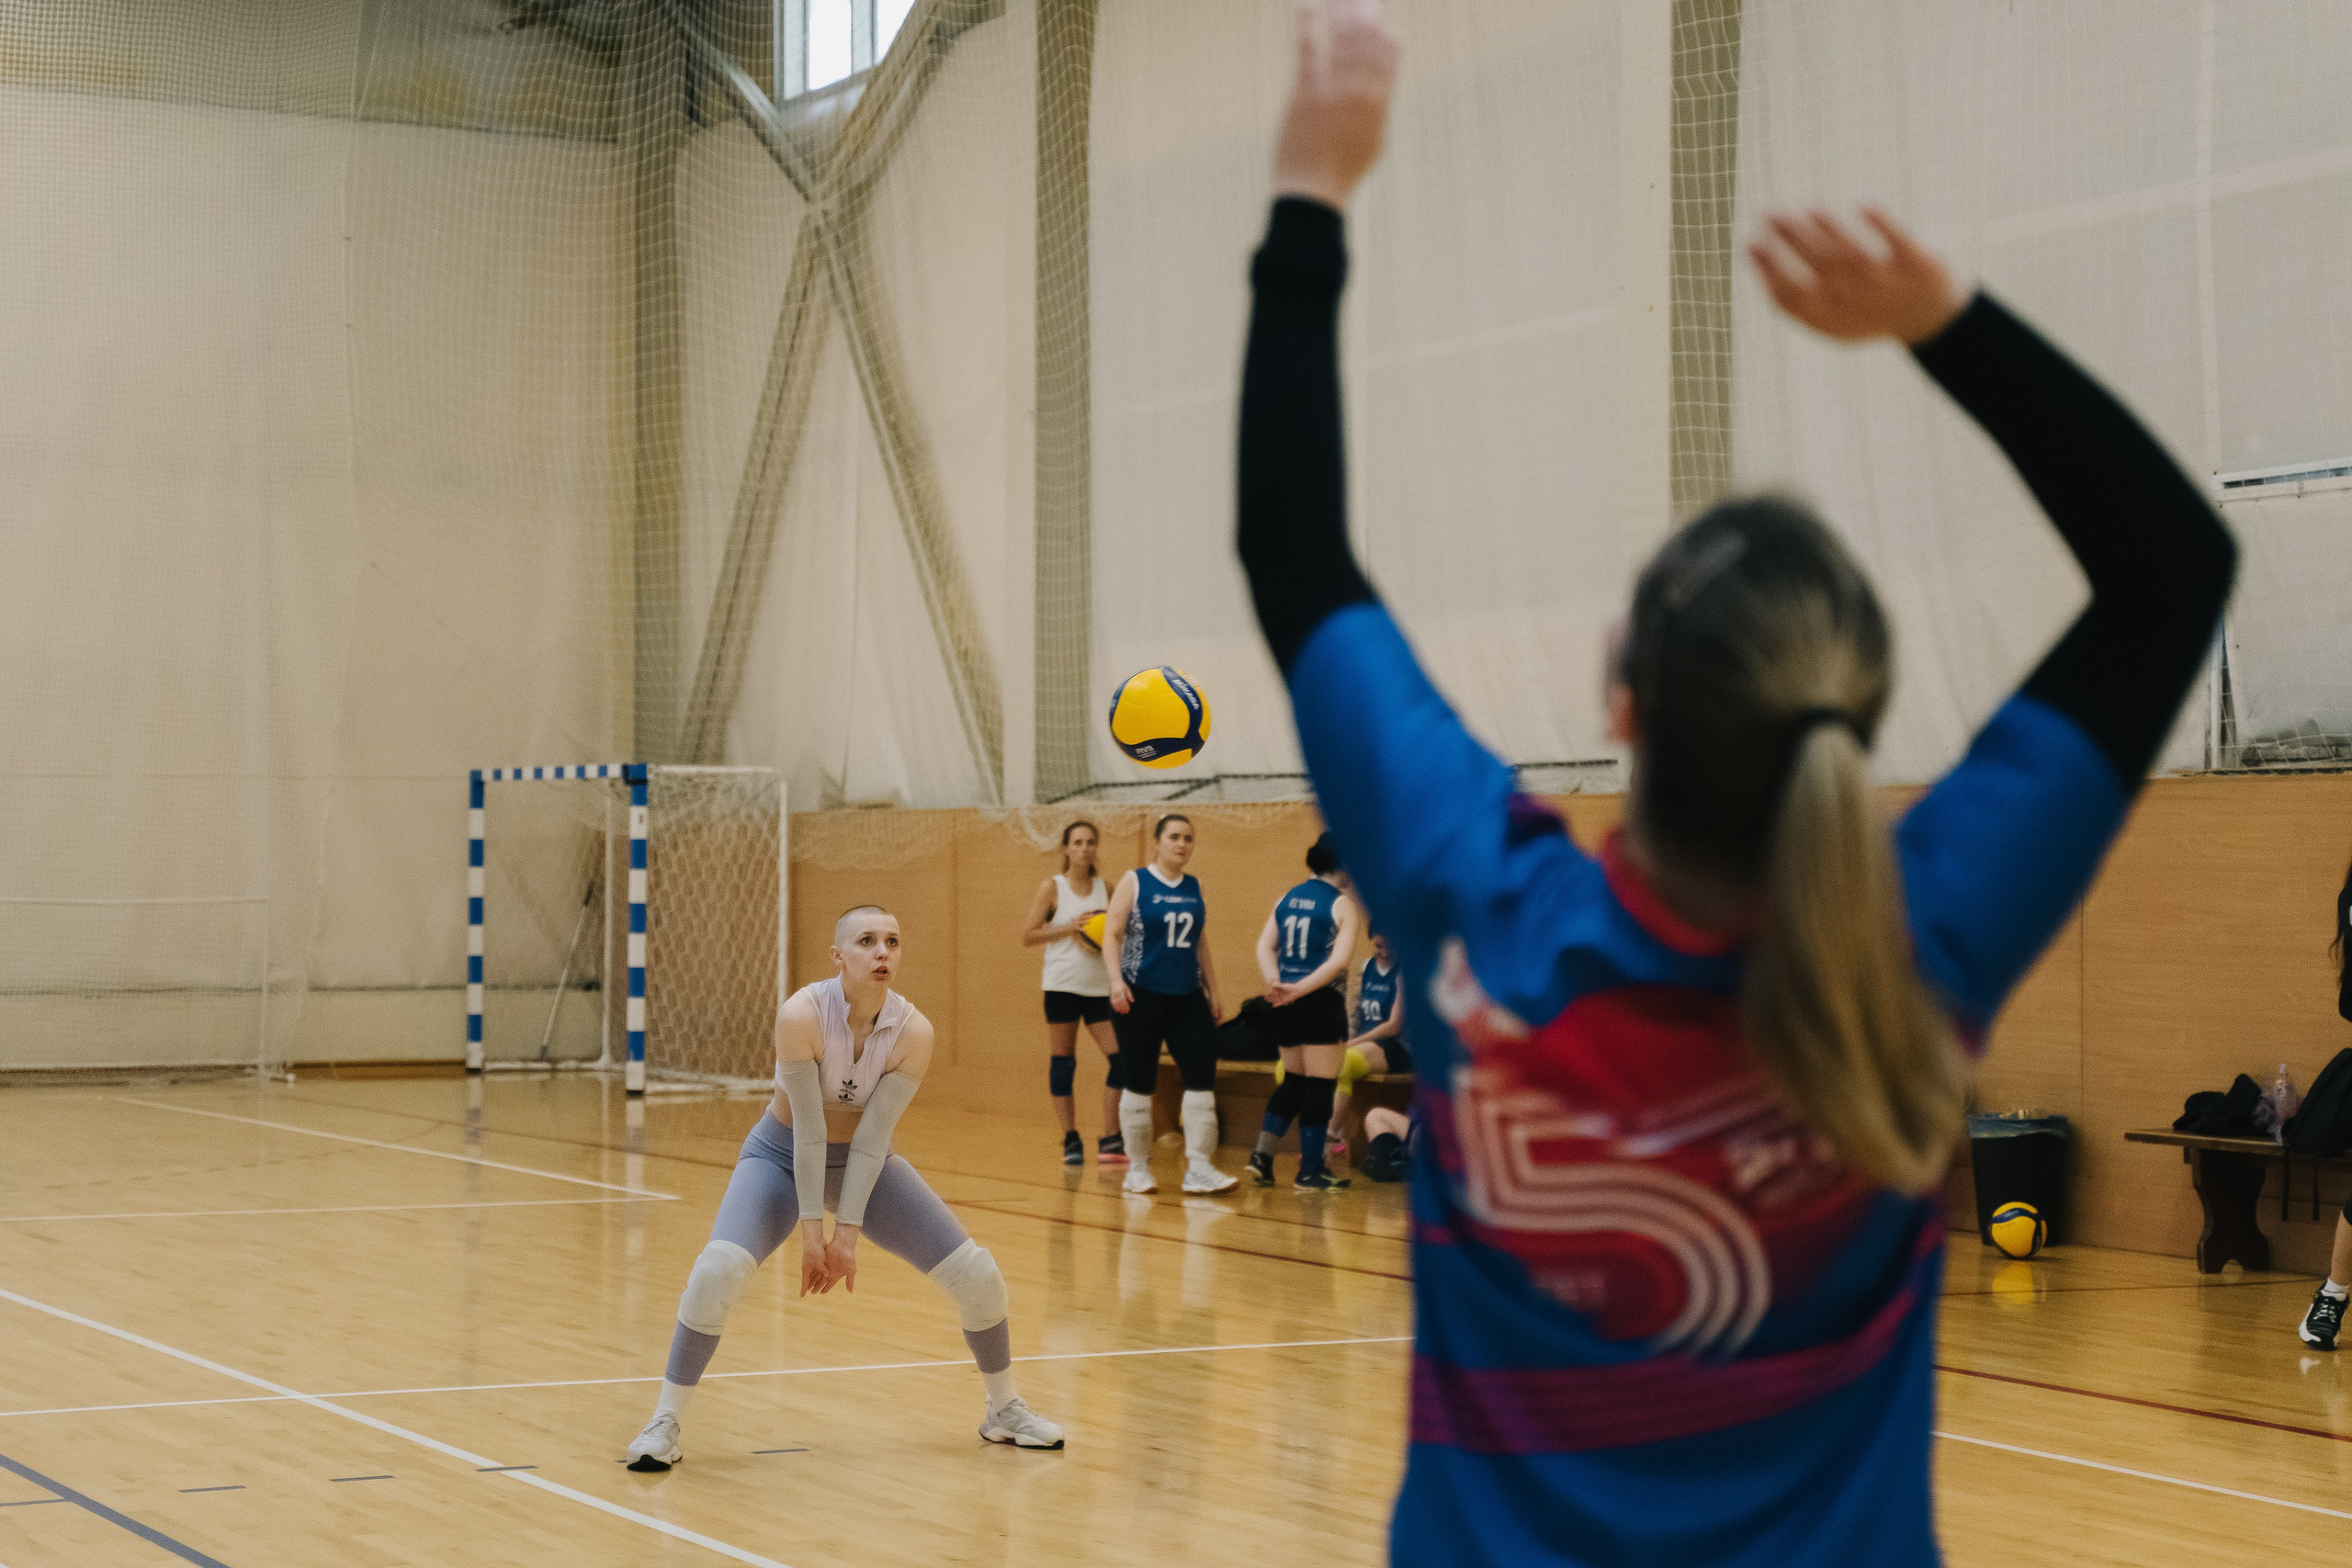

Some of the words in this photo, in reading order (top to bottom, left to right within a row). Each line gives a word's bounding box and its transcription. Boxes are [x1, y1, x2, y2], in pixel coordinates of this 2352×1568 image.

[1163, 911, 1194, 948] 12
[1284, 915, 1311, 960] 11
[1449, 1066, 1773, 1367] 5
